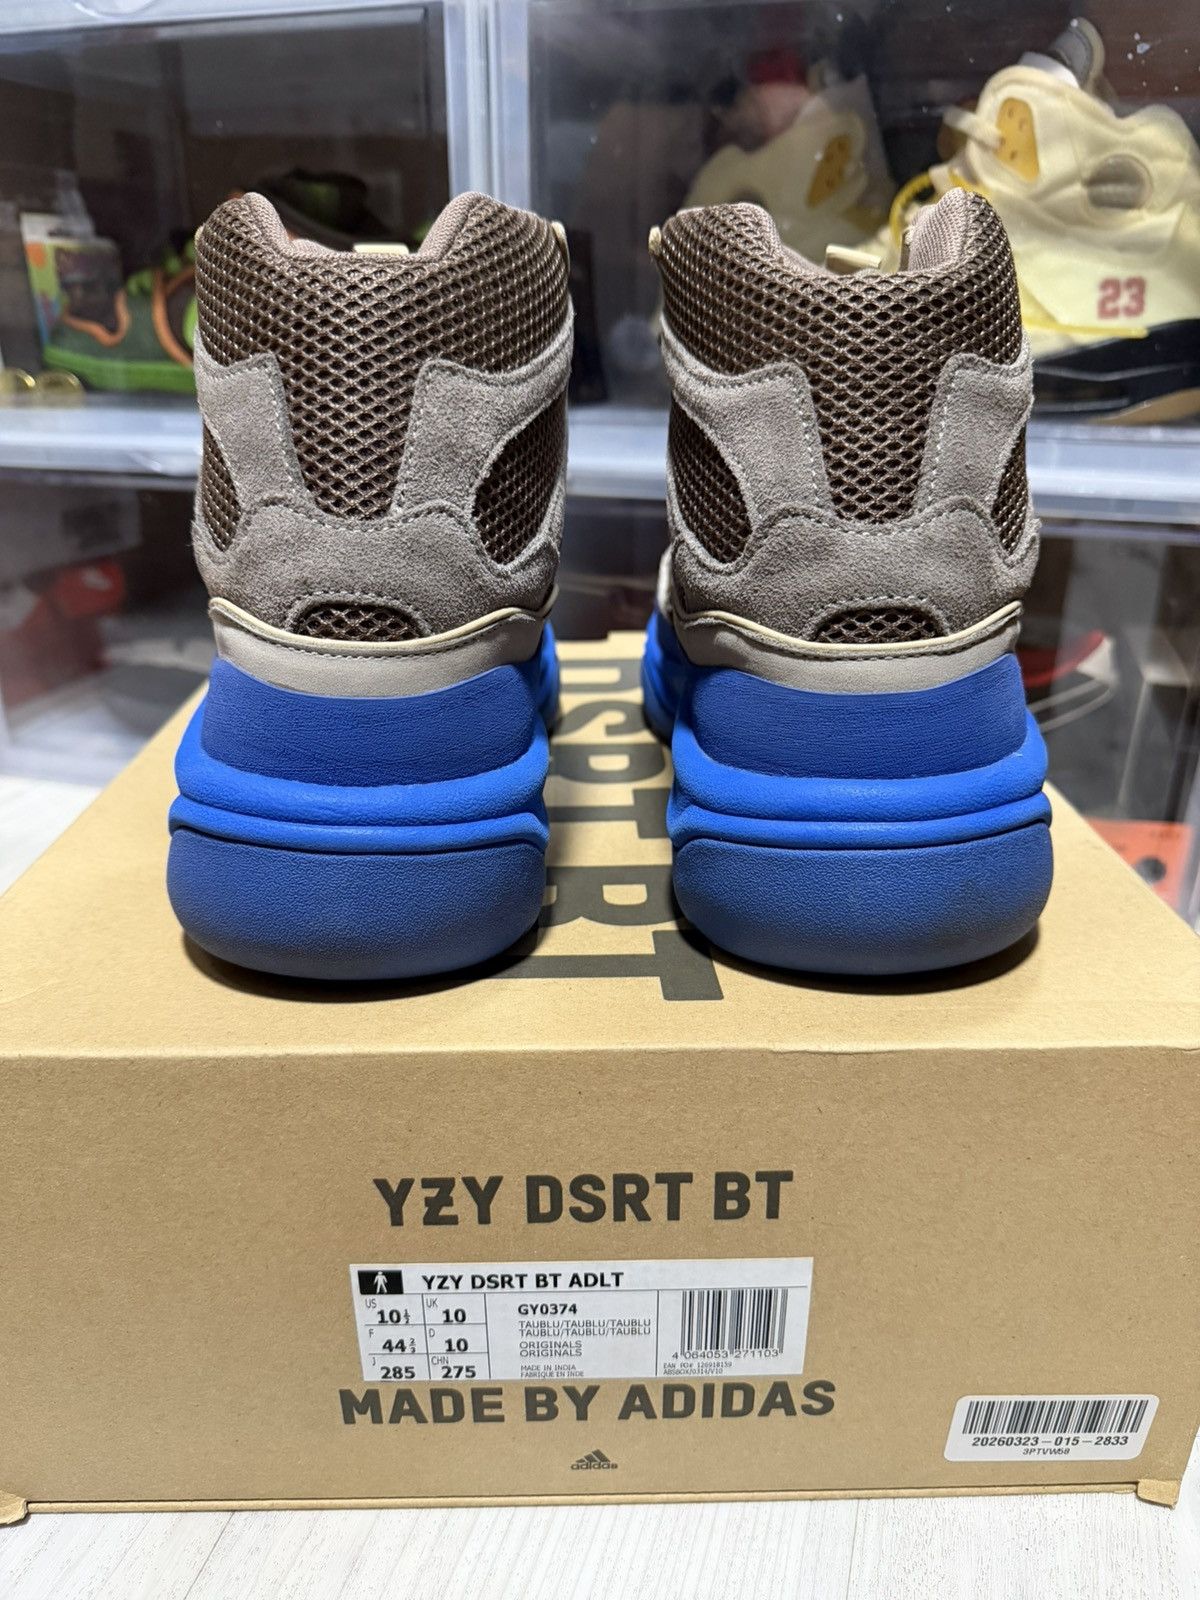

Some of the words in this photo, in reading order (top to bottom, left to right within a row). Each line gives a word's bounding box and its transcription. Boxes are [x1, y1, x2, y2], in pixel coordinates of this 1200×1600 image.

[1098, 276, 1146, 319] 23
[526, 1172, 693, 1223] DSRT
[714, 1170, 793, 1220] BT
[422, 1274, 463, 1290] YZY
[471, 1273, 528, 1289] DSRT
[535, 1273, 562, 1288] BT
[569, 1272, 624, 1288] ADLT
[365, 1298, 377, 1308] US
[426, 1298, 438, 1308] UK
[518, 1303, 577, 1315] GY0374
[442, 1308, 467, 1323] 10
[519, 1319, 651, 1329] TAUBLU/TAUBLU/TAUBLU
[368, 1329, 374, 1338] F
[429, 1328, 435, 1337] D
[519, 1328, 651, 1337] TAUBLU/TAUBLU/TAUBLU
[444, 1338, 469, 1352] 10
[519, 1340, 582, 1349] ORIGINALS
[519, 1348, 582, 1357] ORIGINALS
[683, 1351, 729, 1359] 064053
[734, 1350, 779, 1358] 271103
[431, 1356, 449, 1365] CHN
[380, 1366, 416, 1380] 285
[441, 1365, 476, 1379] 275
[339, 1387, 505, 1424] MADE
[525, 1384, 600, 1421] BY
[618, 1380, 836, 1421] ADIDAS
